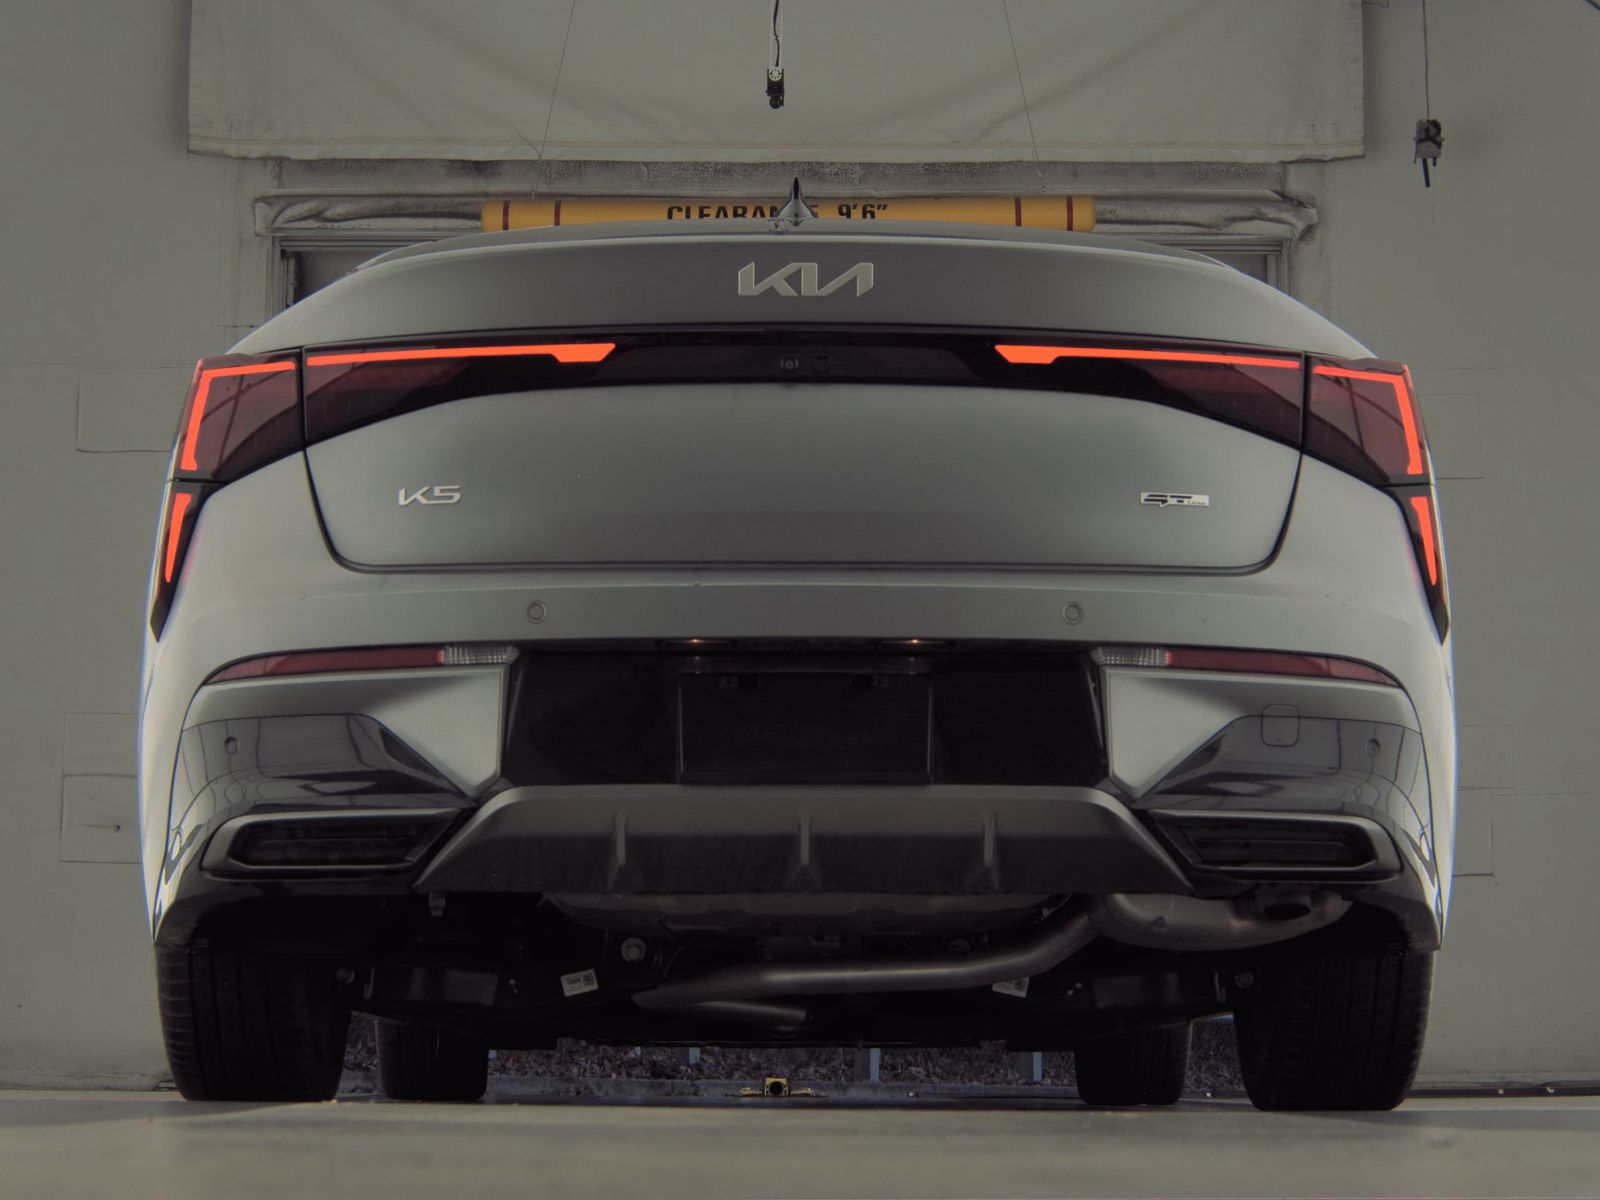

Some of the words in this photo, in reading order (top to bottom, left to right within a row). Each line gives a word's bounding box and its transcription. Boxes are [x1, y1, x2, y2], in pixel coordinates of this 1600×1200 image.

[667, 205, 819, 220] CLEARA
[738, 262, 874, 297] KIA
[398, 485, 461, 506] K5
